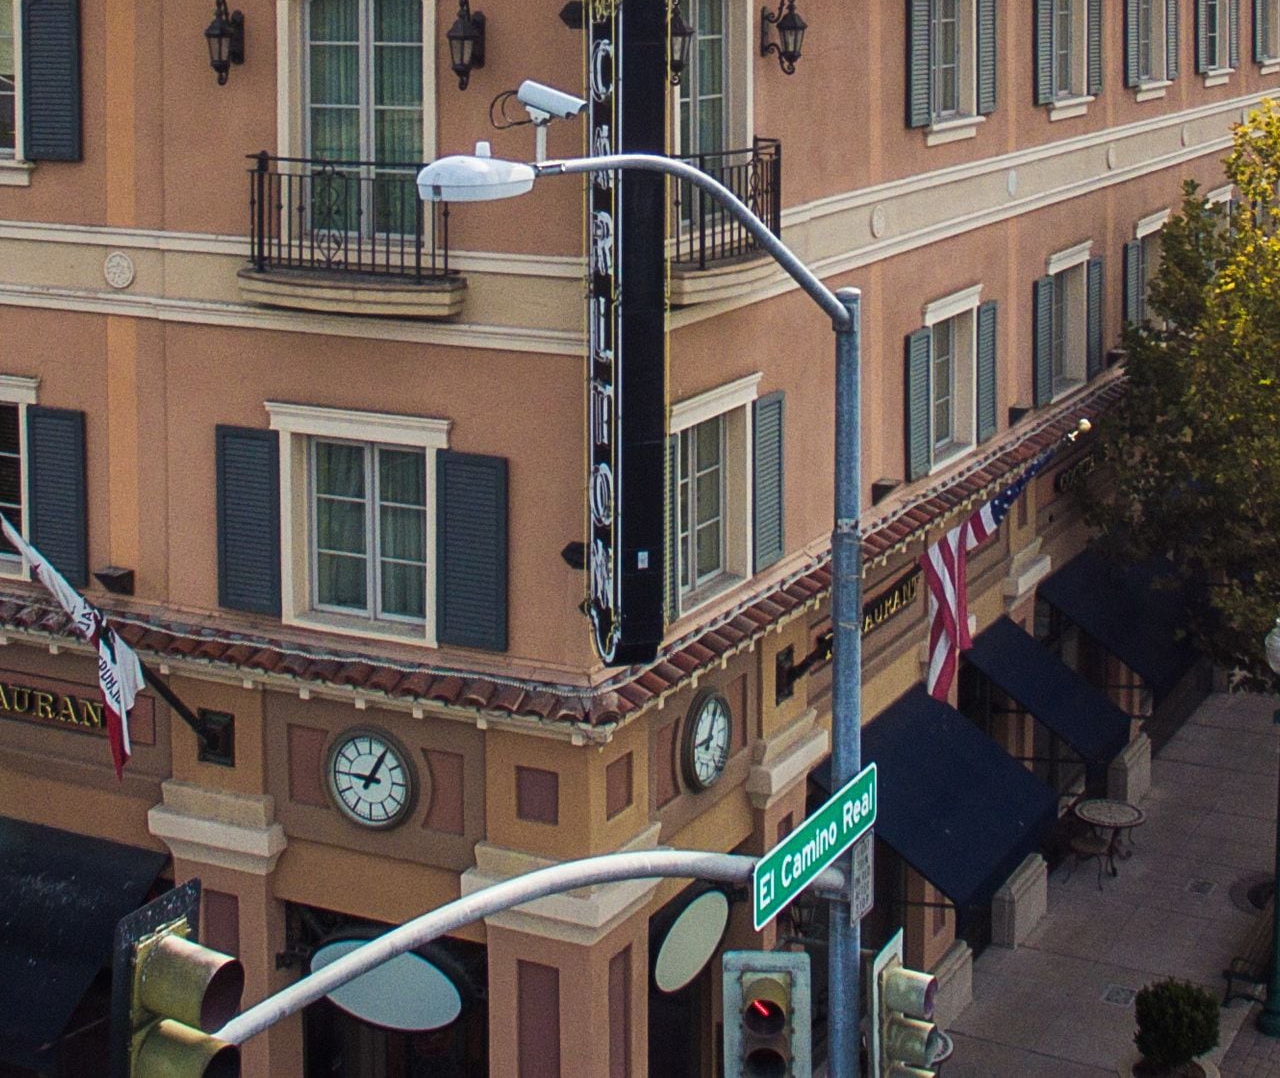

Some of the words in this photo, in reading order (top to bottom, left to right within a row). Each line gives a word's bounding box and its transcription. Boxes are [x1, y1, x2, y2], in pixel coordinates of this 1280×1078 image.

[759, 868, 775, 910] El
[781, 821, 837, 888] Camino
[843, 782, 872, 833] Real
